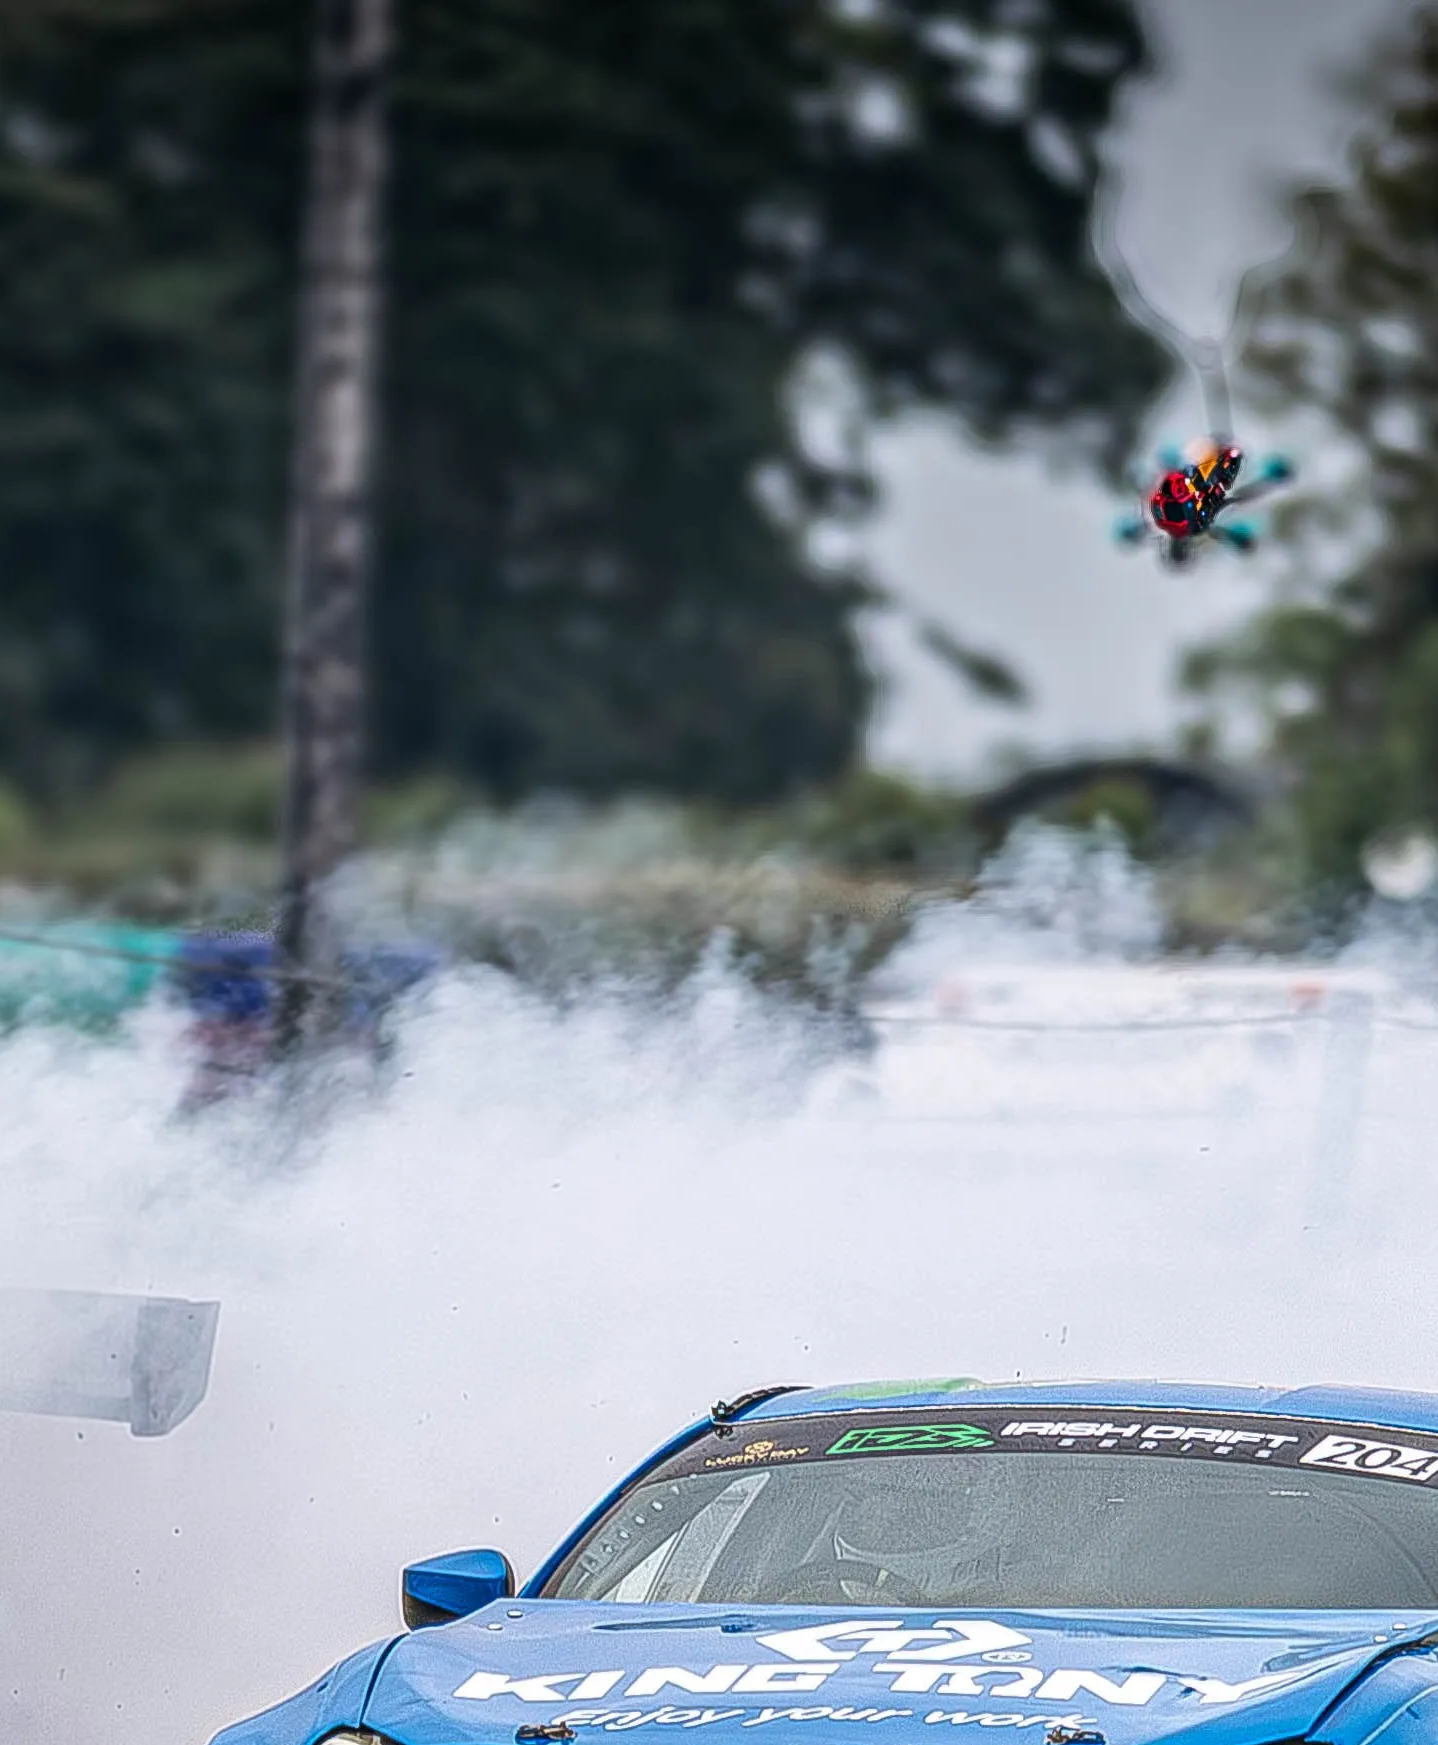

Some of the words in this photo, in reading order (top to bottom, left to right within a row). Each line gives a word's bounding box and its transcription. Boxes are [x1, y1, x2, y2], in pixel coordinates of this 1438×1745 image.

[1000, 1421, 1142, 1438] IRISH
[1140, 1424, 1299, 1449] DRIFT
[1057, 1438, 1273, 1459] SERIES
[452, 1662, 842, 1702] KING
[872, 1662, 1302, 1705] TONY
[551, 1704, 745, 1732] Enjoy
[741, 1706, 913, 1728] your
[924, 1709, 1098, 1729] work
